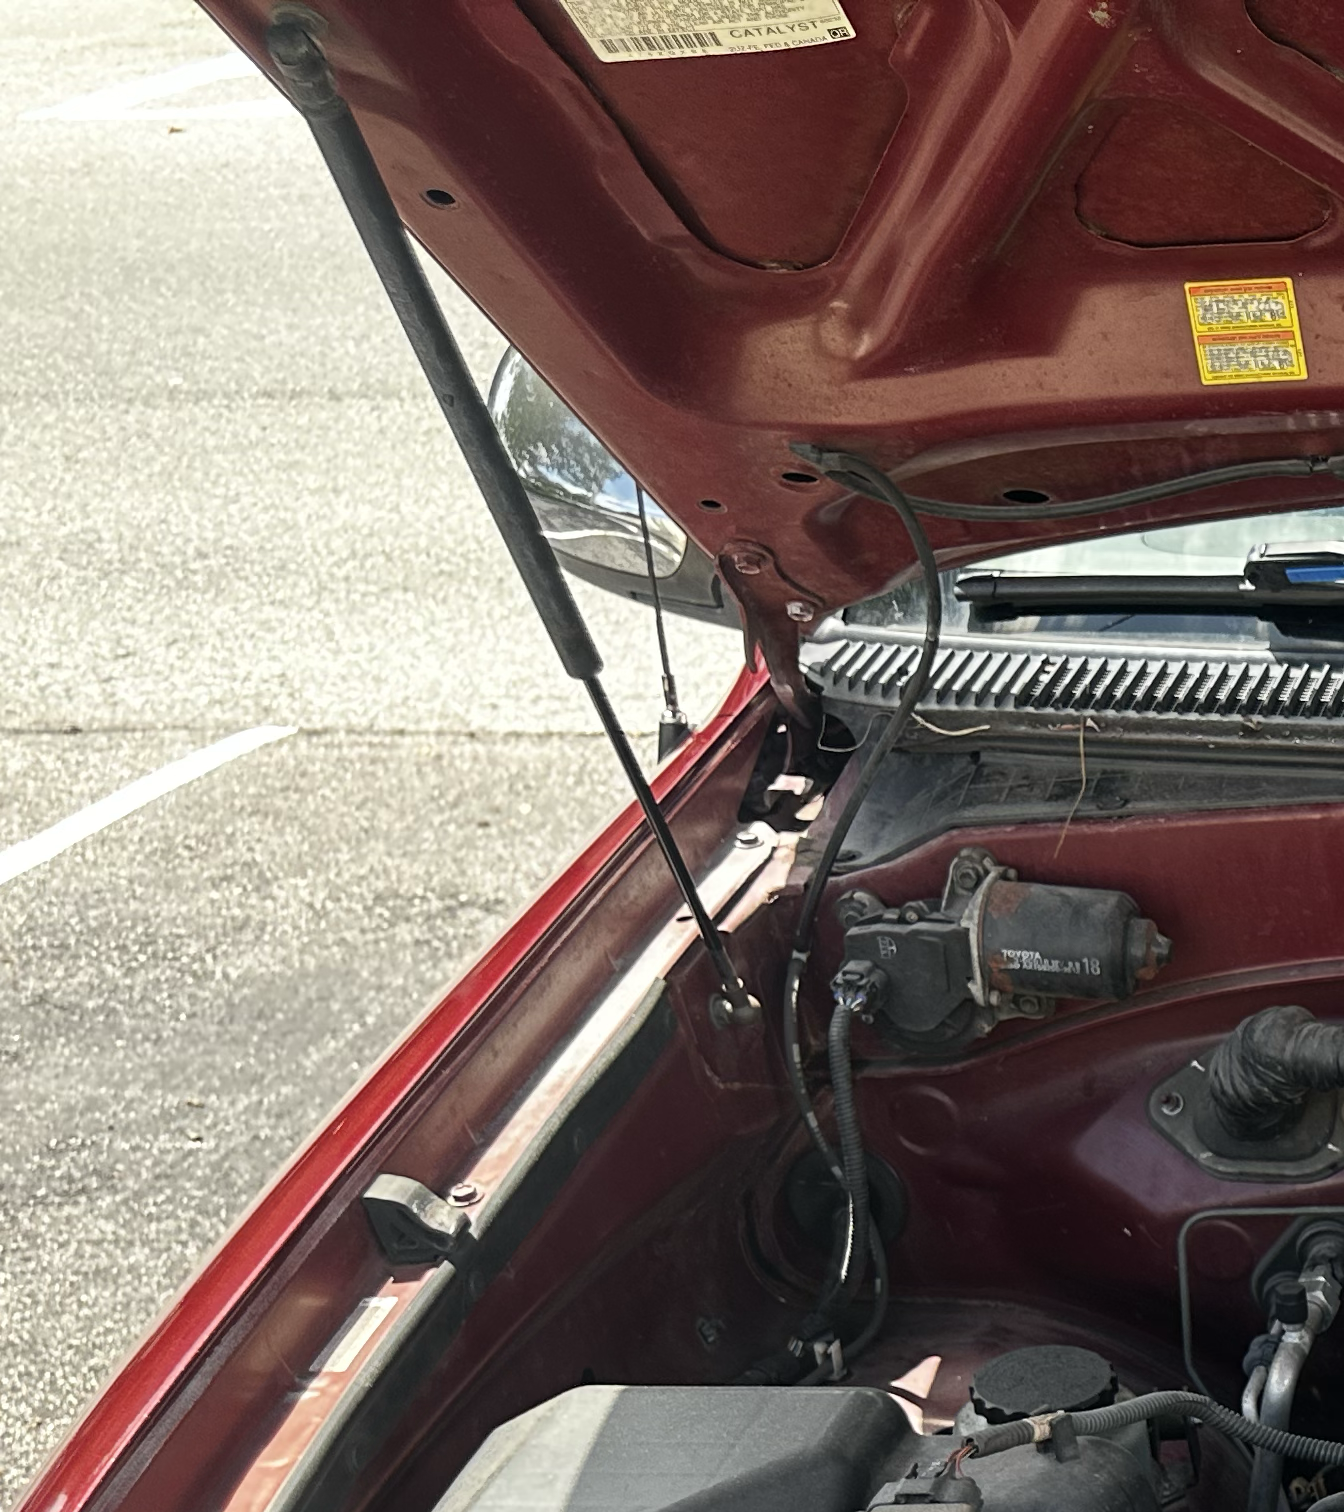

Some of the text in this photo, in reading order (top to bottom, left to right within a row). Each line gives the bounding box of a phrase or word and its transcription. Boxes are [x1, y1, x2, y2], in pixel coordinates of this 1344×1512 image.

[729, 20, 818, 39] CATALYST
[1001, 949, 1041, 960] TOYOTA
[1082, 958, 1101, 976] 18
